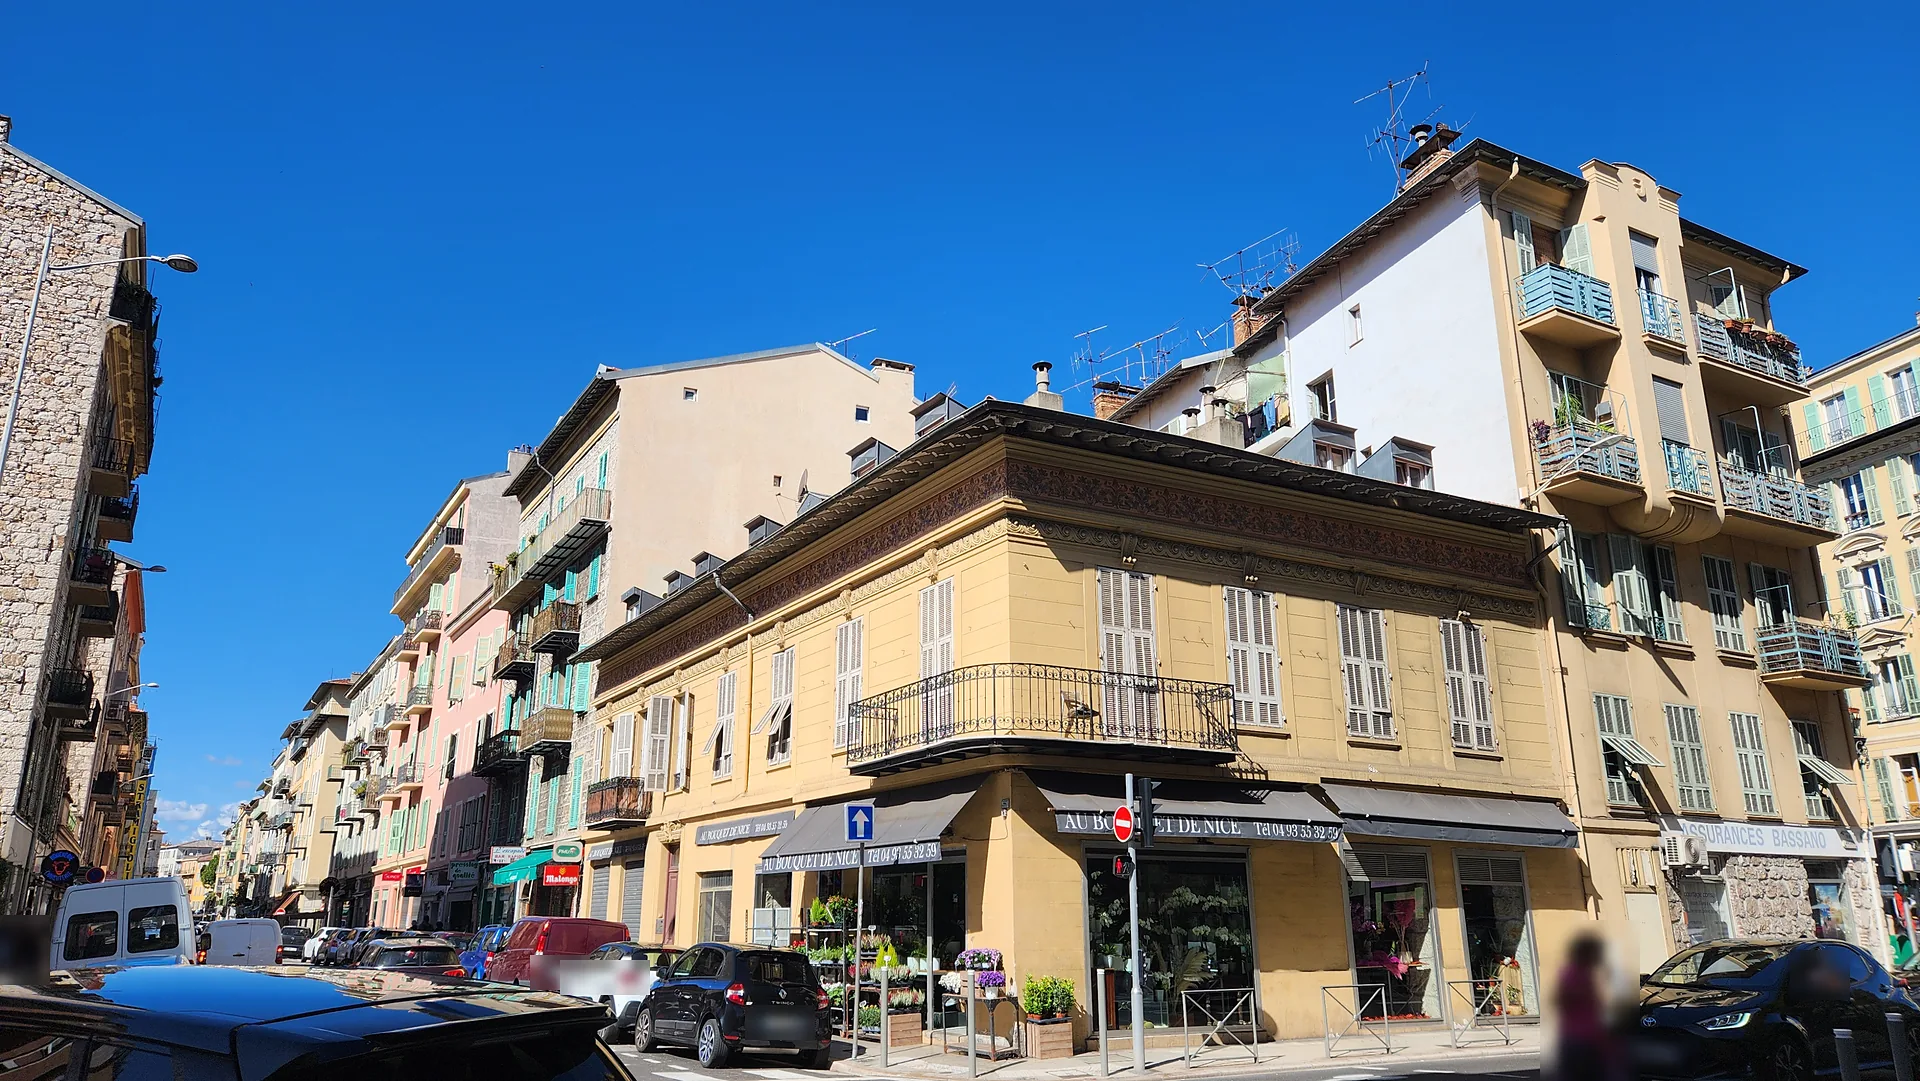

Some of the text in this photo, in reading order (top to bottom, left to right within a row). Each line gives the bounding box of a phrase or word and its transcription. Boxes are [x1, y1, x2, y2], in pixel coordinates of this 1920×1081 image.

[1065, 813, 1339, 839] AU BOET DE NICE Tél 04 93 55 32 59
[1681, 823, 1827, 849] ASSURANCES BASSANO
[450, 861, 479, 870] pressing
[764, 858, 775, 871] AU
[775, 852, 820, 870] BOUQUET
[820, 852, 834, 868] DE
[834, 849, 859, 867] NICE
[867, 850, 880, 863] Tél
[880, 849, 890, 862] 04
[902, 847, 912, 860] 55
[913, 845, 924, 859] 32
[925, 843, 937, 858] 59
[452, 871, 476, 880] qualité
[545, 875, 578, 885] Malongo
